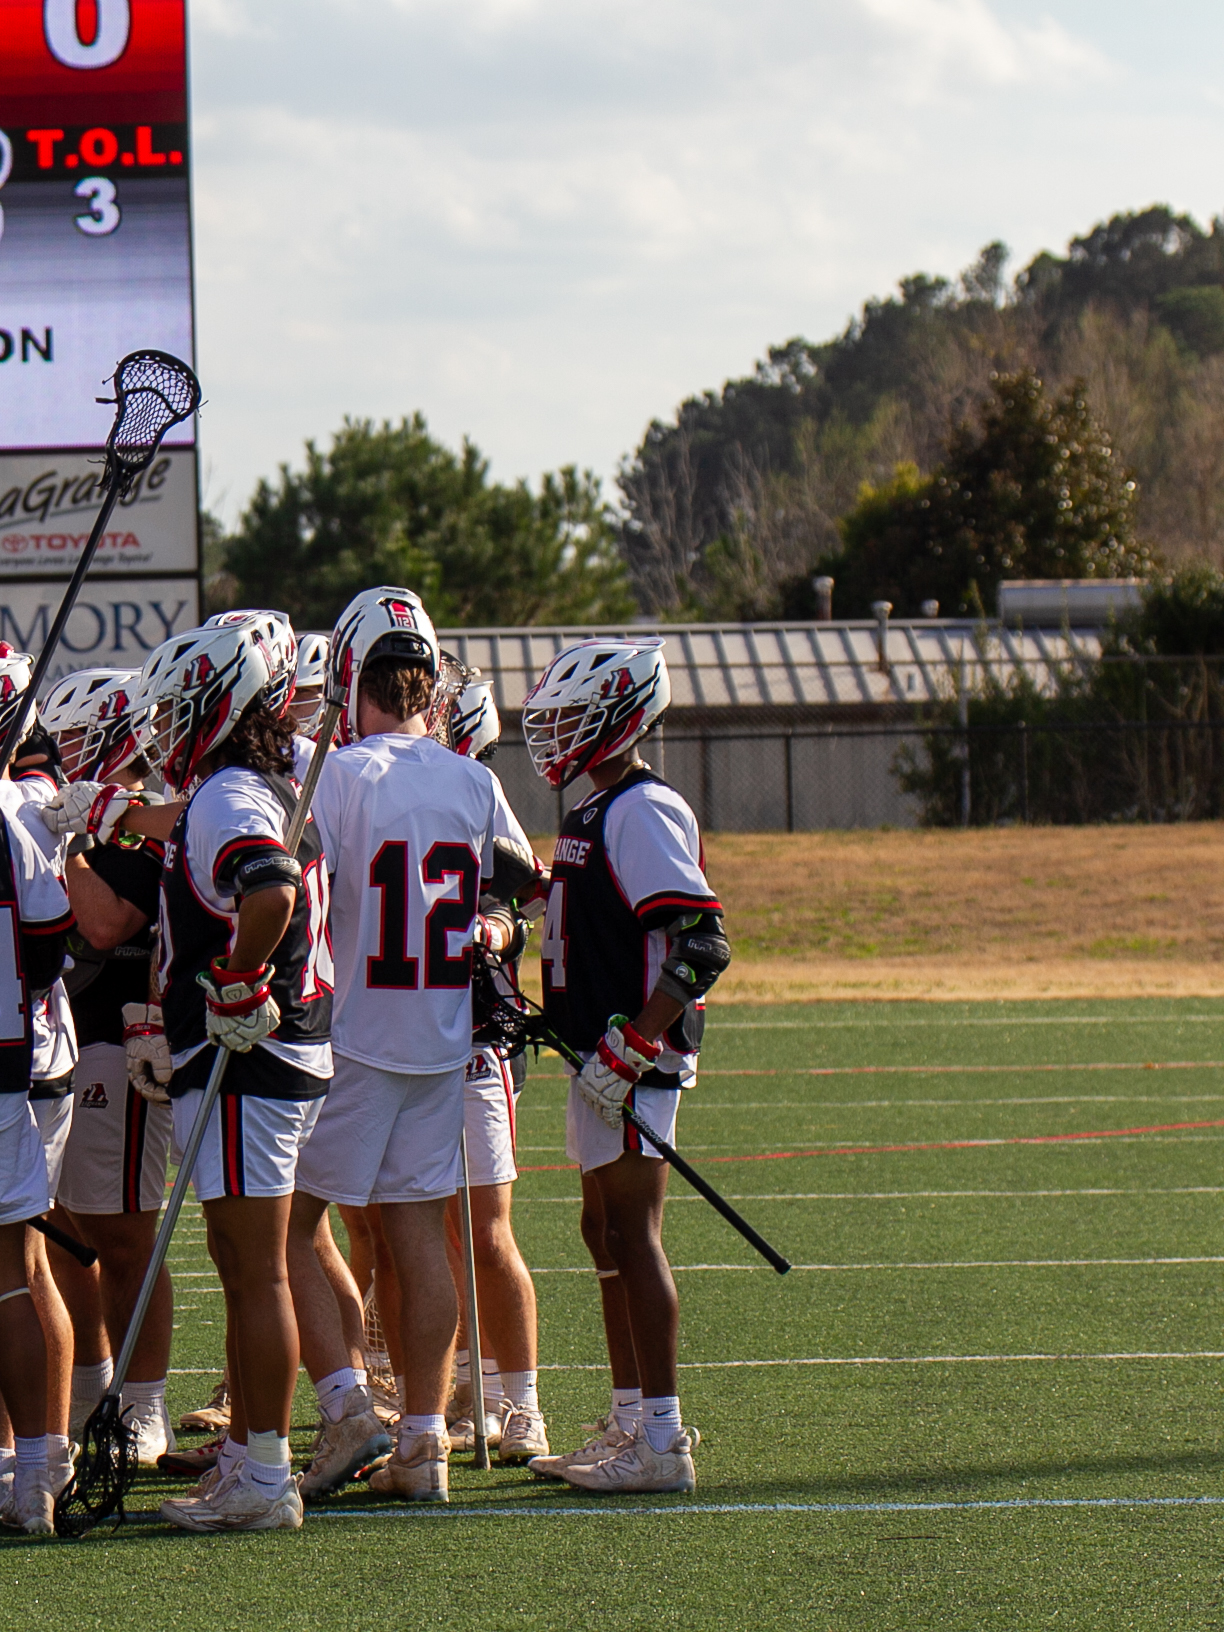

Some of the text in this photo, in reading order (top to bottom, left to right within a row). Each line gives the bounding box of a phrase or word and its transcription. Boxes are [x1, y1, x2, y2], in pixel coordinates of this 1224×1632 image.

[26, 126, 183, 169] T.O.L.
[75, 176, 121, 236] 3
[397, 616, 411, 627] 12
[366, 839, 481, 991] 12
